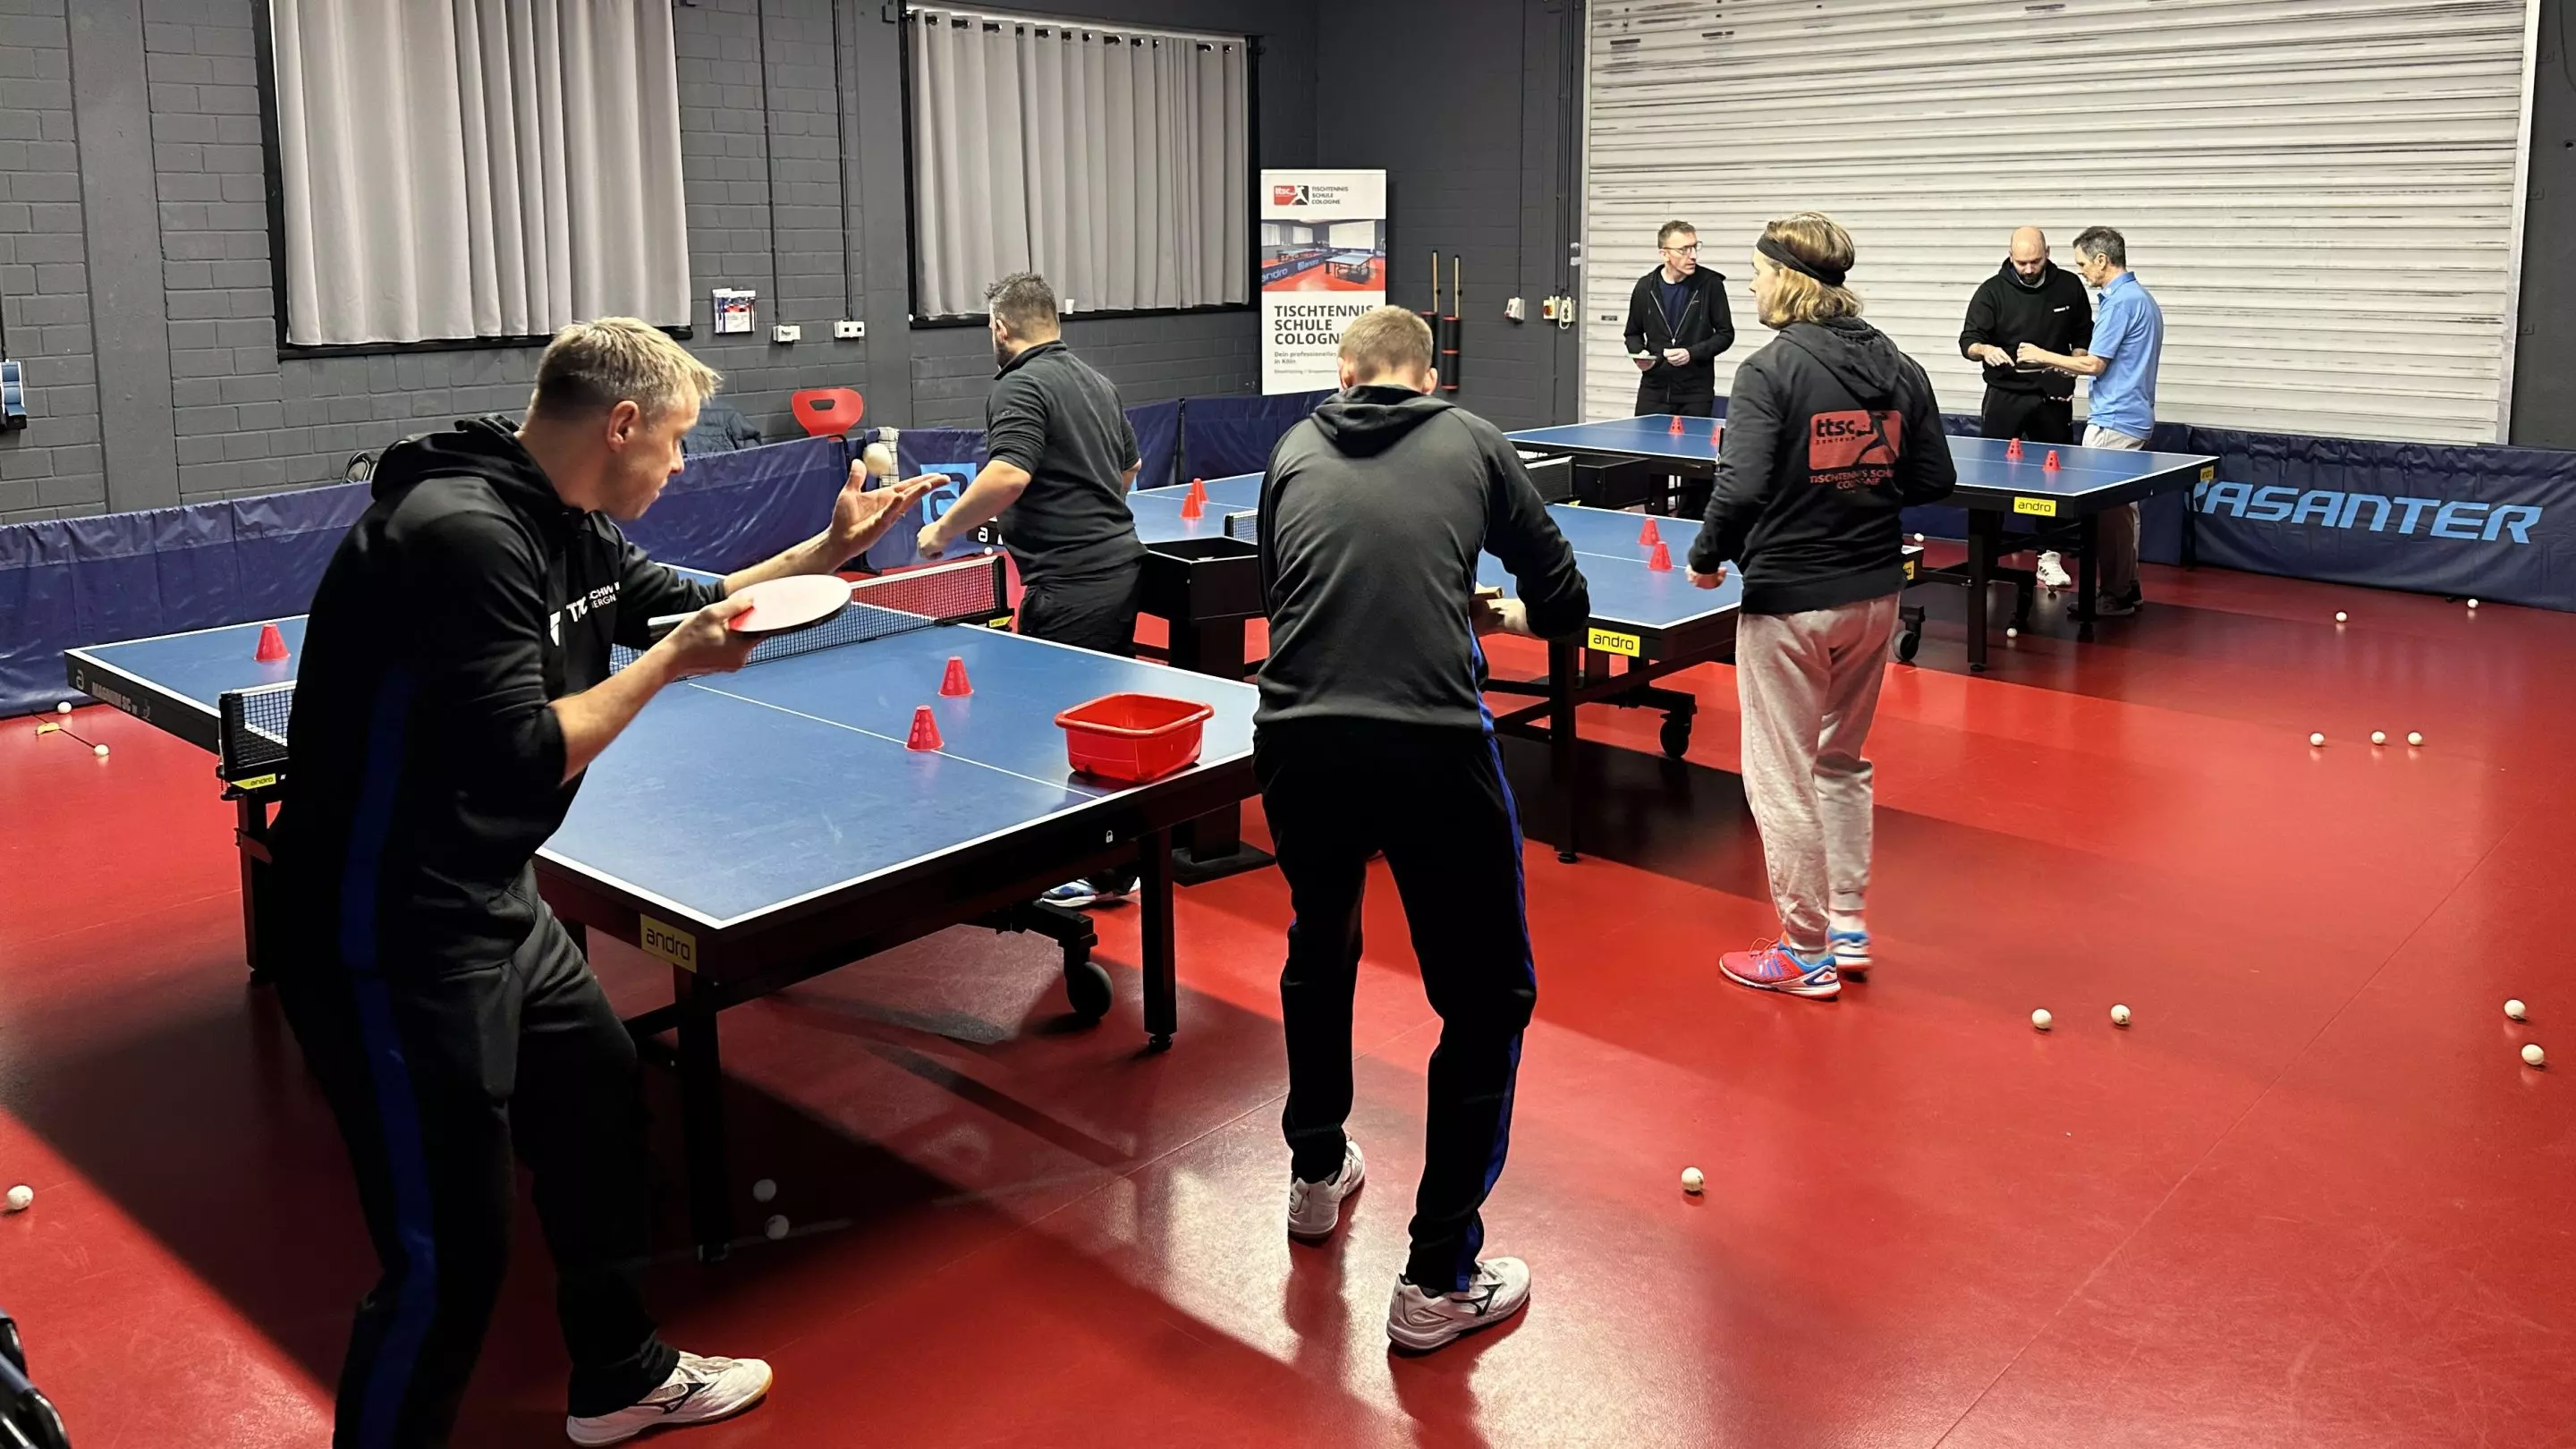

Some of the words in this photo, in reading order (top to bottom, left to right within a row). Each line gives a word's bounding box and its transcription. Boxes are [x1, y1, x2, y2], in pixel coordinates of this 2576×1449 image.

[1275, 319, 1333, 331] SCHULE
[1275, 333, 1343, 345] COLOGN
[1817, 418, 1855, 437] ttsc
[2018, 502, 2052, 513] andro
[1593, 633, 1634, 650] andro
[250, 776, 274, 786] andro
[646, 927, 691, 962] andro
